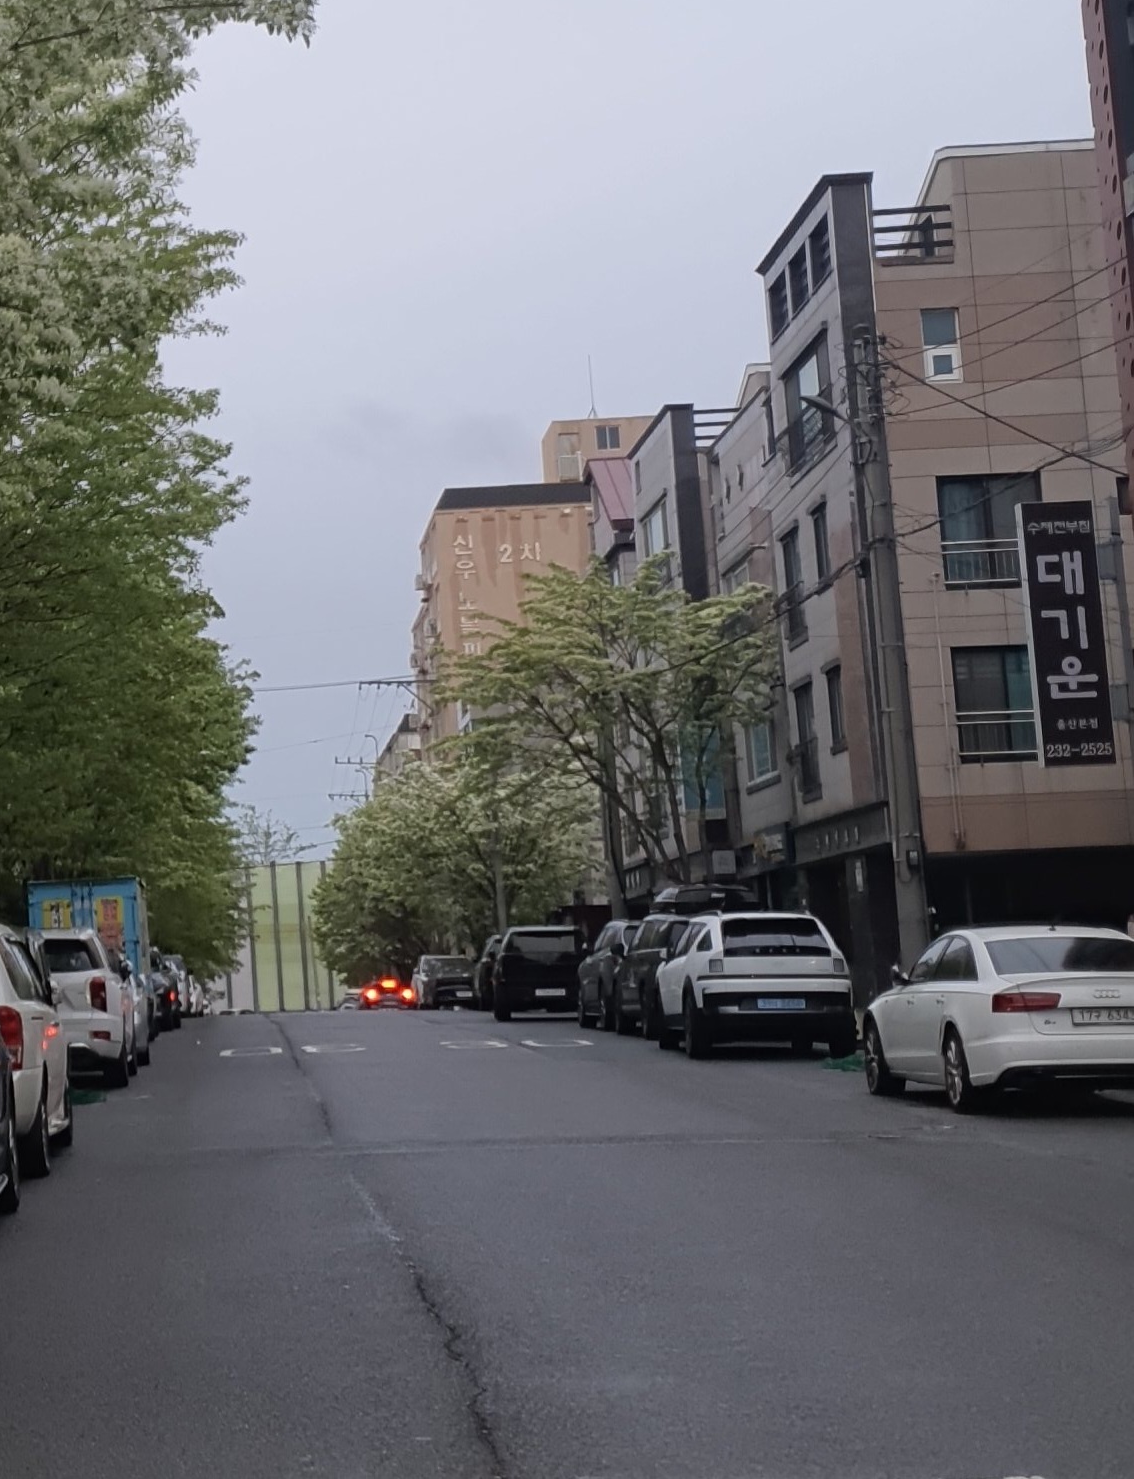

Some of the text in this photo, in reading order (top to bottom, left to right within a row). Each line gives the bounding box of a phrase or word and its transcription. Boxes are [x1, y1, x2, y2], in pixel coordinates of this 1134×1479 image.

[499, 542, 541, 563] 2차
[1035, 550, 1099, 699] 대기운
[1046, 742, 1113, 757] 232-2525
